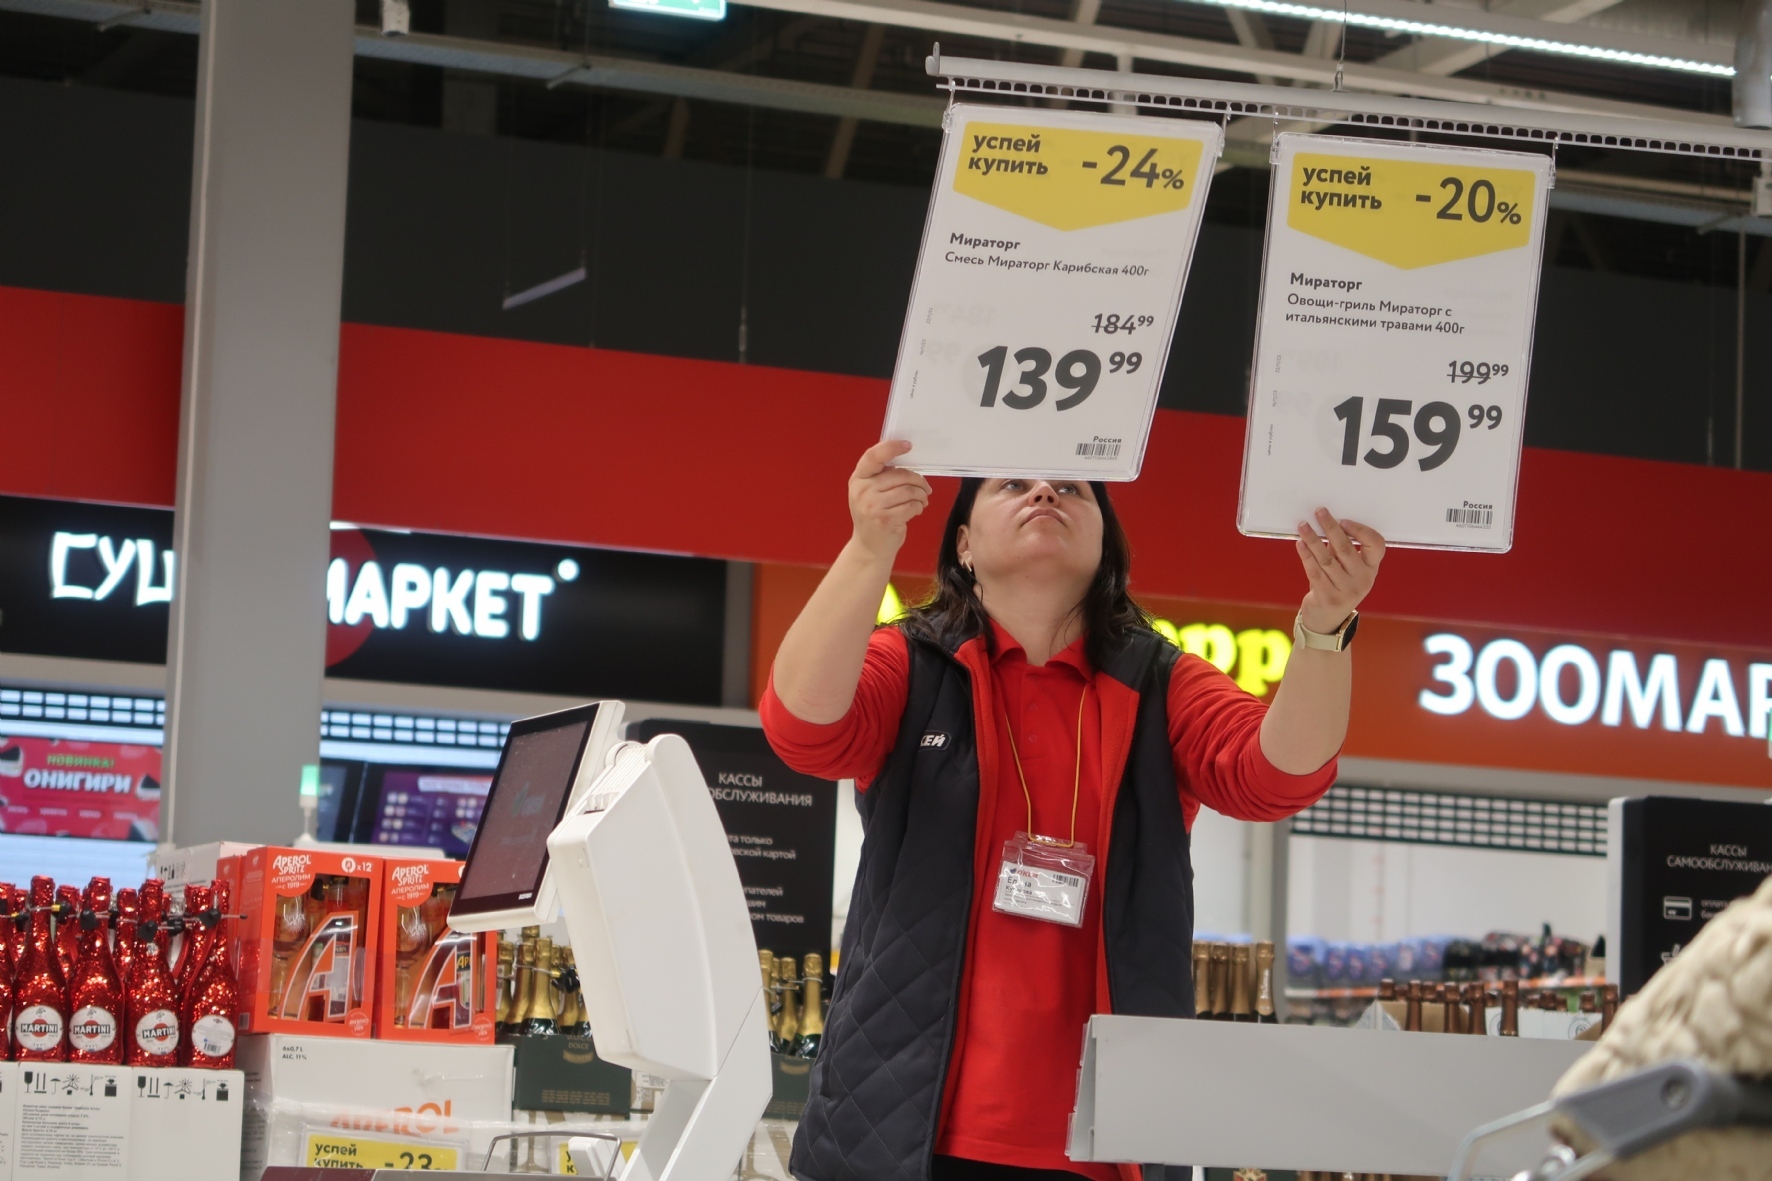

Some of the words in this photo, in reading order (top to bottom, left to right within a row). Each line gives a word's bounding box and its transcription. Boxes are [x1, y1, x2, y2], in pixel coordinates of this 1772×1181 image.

[973, 134, 1041, 153] успей
[968, 154, 1048, 175] купить
[1082, 145, 1184, 190] -24%
[1302, 166, 1371, 186] успей
[1301, 189, 1382, 210] купить
[1416, 177, 1521, 225] -20%
[950, 233, 1021, 251] Мираторг
[945, 252, 984, 265] Смесь
[988, 255, 1050, 272] Мираторг
[1053, 260, 1119, 275] Карибская
[1121, 265, 1149, 276] 400г
[1290, 273, 1362, 292] Мираторг
[1287, 294, 1376, 312] Овощи-гриль
[1379, 301, 1442, 317] Мираторг
[1445, 309, 1452, 317] с
[1285, 313, 1377, 328] итальянскими
[1380, 321, 1432, 332] травами
[1435, 322, 1465, 335] 400г
[977, 345, 1102, 411] 139
[1108, 351, 1142, 375] 99
[1093, 435, 1122, 444] Россия
[1333, 396, 1461, 472] 159
[1468, 404, 1503, 430] 99
[1463, 501, 1493, 510] Россия
[23, 768, 132, 794] ОНИГИРИ
[718, 772, 763, 787] КАССЫ
[1710, 844, 1747, 857] КАССЫ
[272, 854, 311, 870] APEROL
[279, 865, 305, 876] SPRITZ
[391, 864, 430, 881] APEROL
[398, 875, 423, 887] SPRITZ
[21, 1024, 59, 1034] MARTINI
[73, 1025, 111, 1034] MARTINI
[142, 1026, 175, 1039] MARTINI
[315, 1143, 357, 1157] успей
